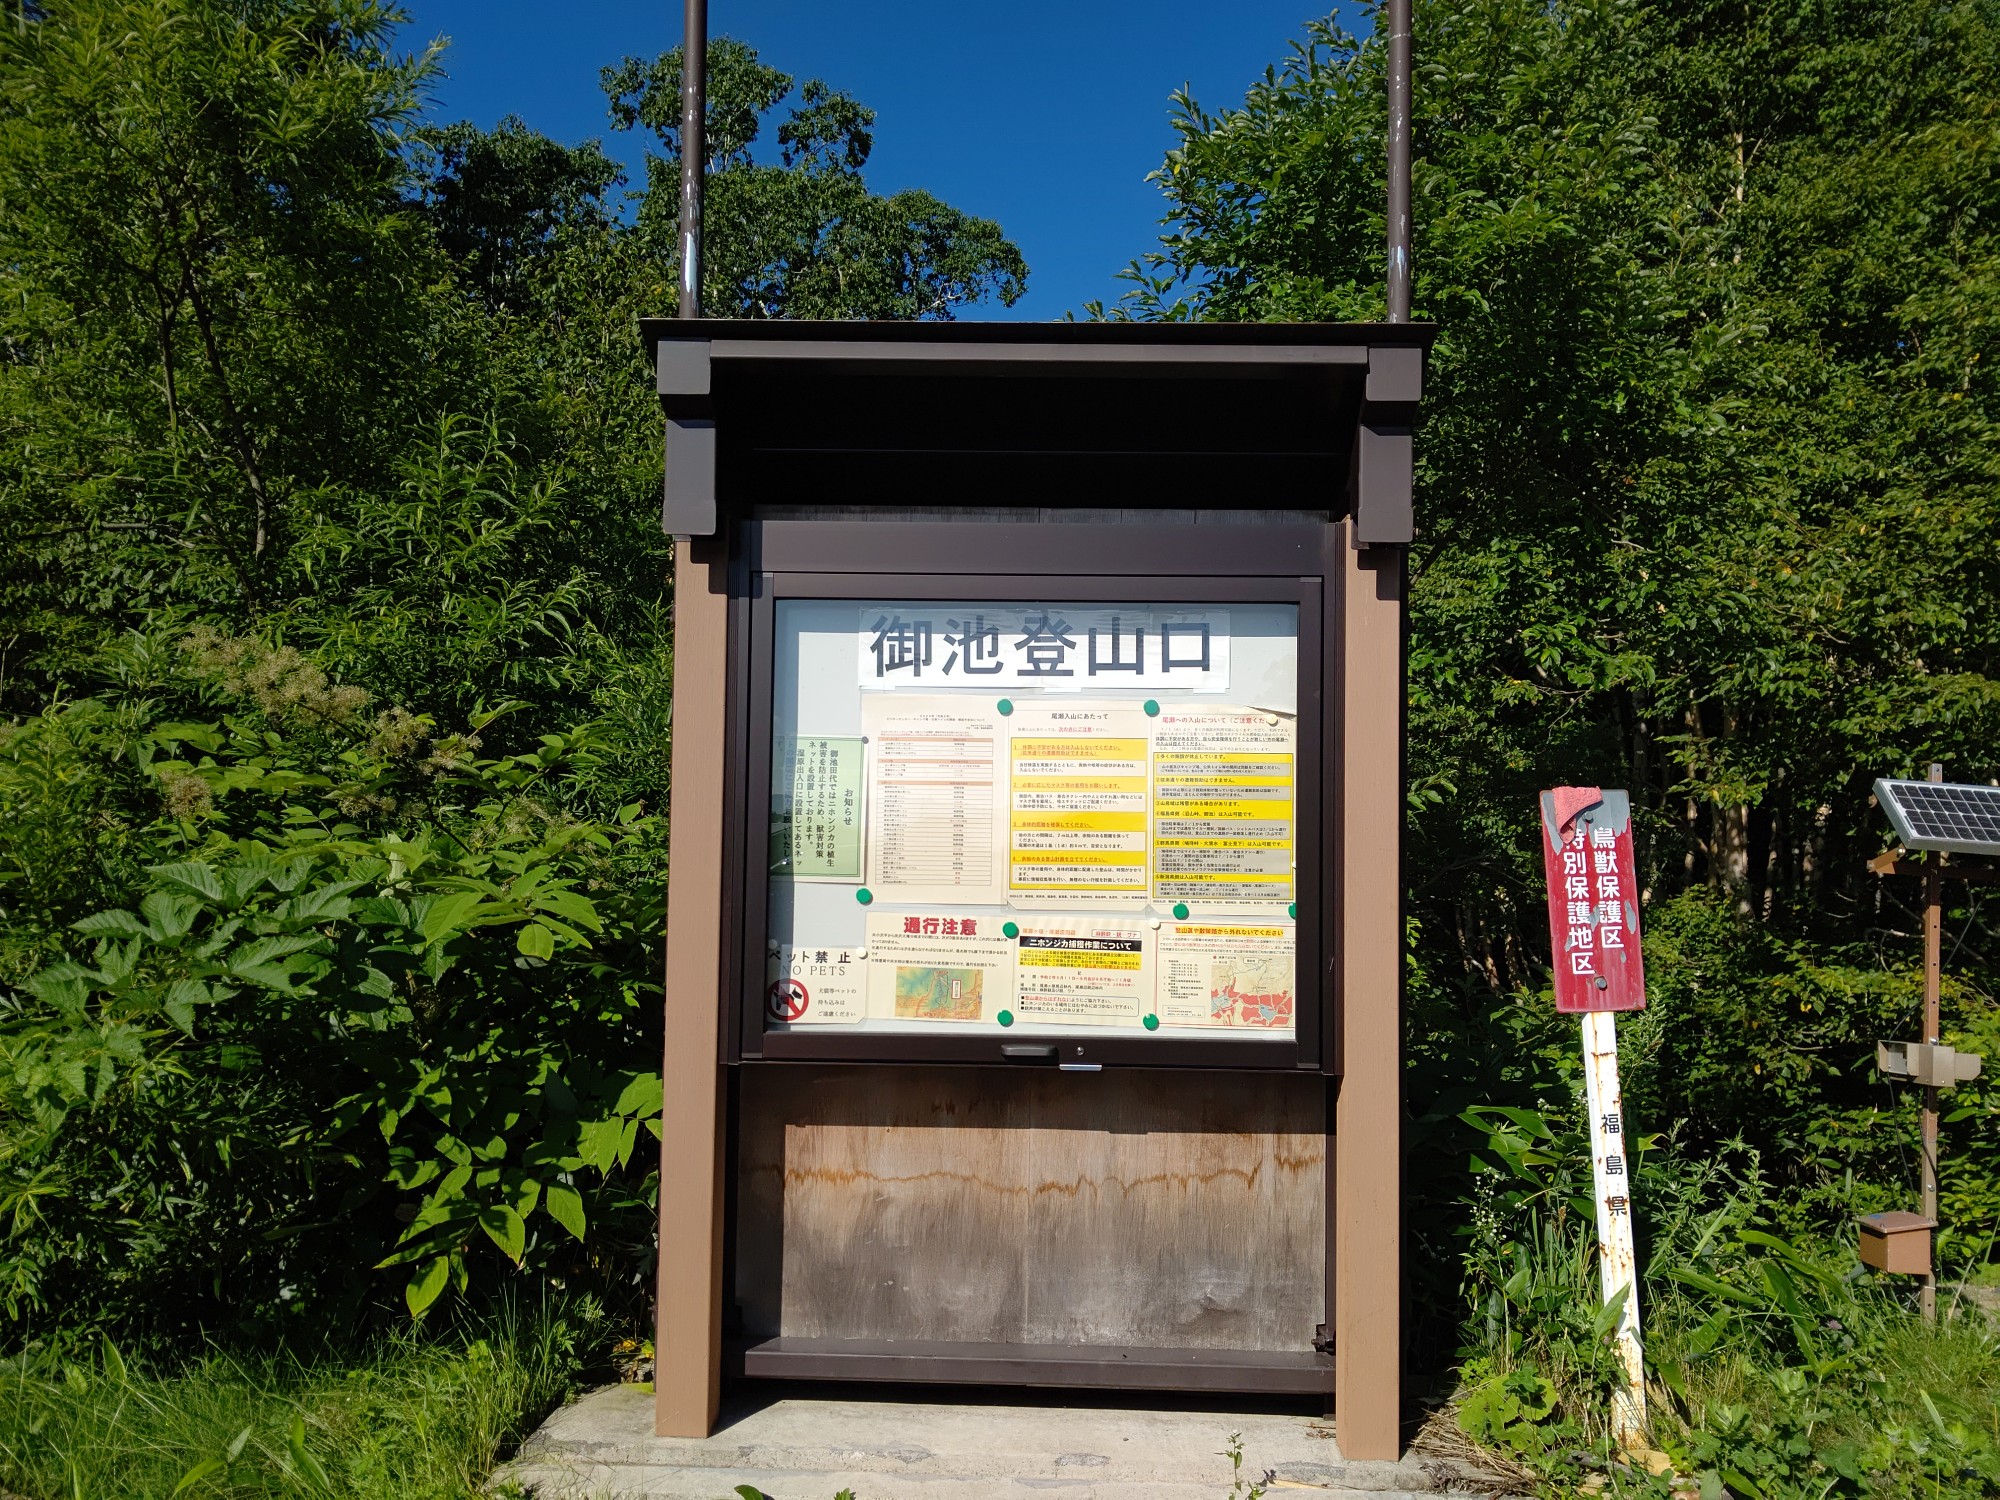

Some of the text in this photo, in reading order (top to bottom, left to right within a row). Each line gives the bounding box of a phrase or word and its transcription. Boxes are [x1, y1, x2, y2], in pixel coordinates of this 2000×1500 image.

[870, 615, 1210, 677] 御池登山口
[805, 741, 816, 845] ネットを設置しております。
[816, 741, 828, 858] 被害を防止するため、獣害対策
[826, 750, 838, 867] 御池田代ではニホンジカの植生
[843, 788, 853, 825] お知らせ
[1594, 827, 1624, 948] 鳥獣保護区
[904, 917, 977, 935] 通行注意
[1029, 939, 1132, 950] ニホンジカ捕獲作業について
[1175, 927, 1284, 936] 登山道や散策路から外れないでください
[769, 950, 852, 963] ペット禁止
[782, 966, 846, 976] NO PETS
[1601, 1113, 1627, 1216] 福島県
